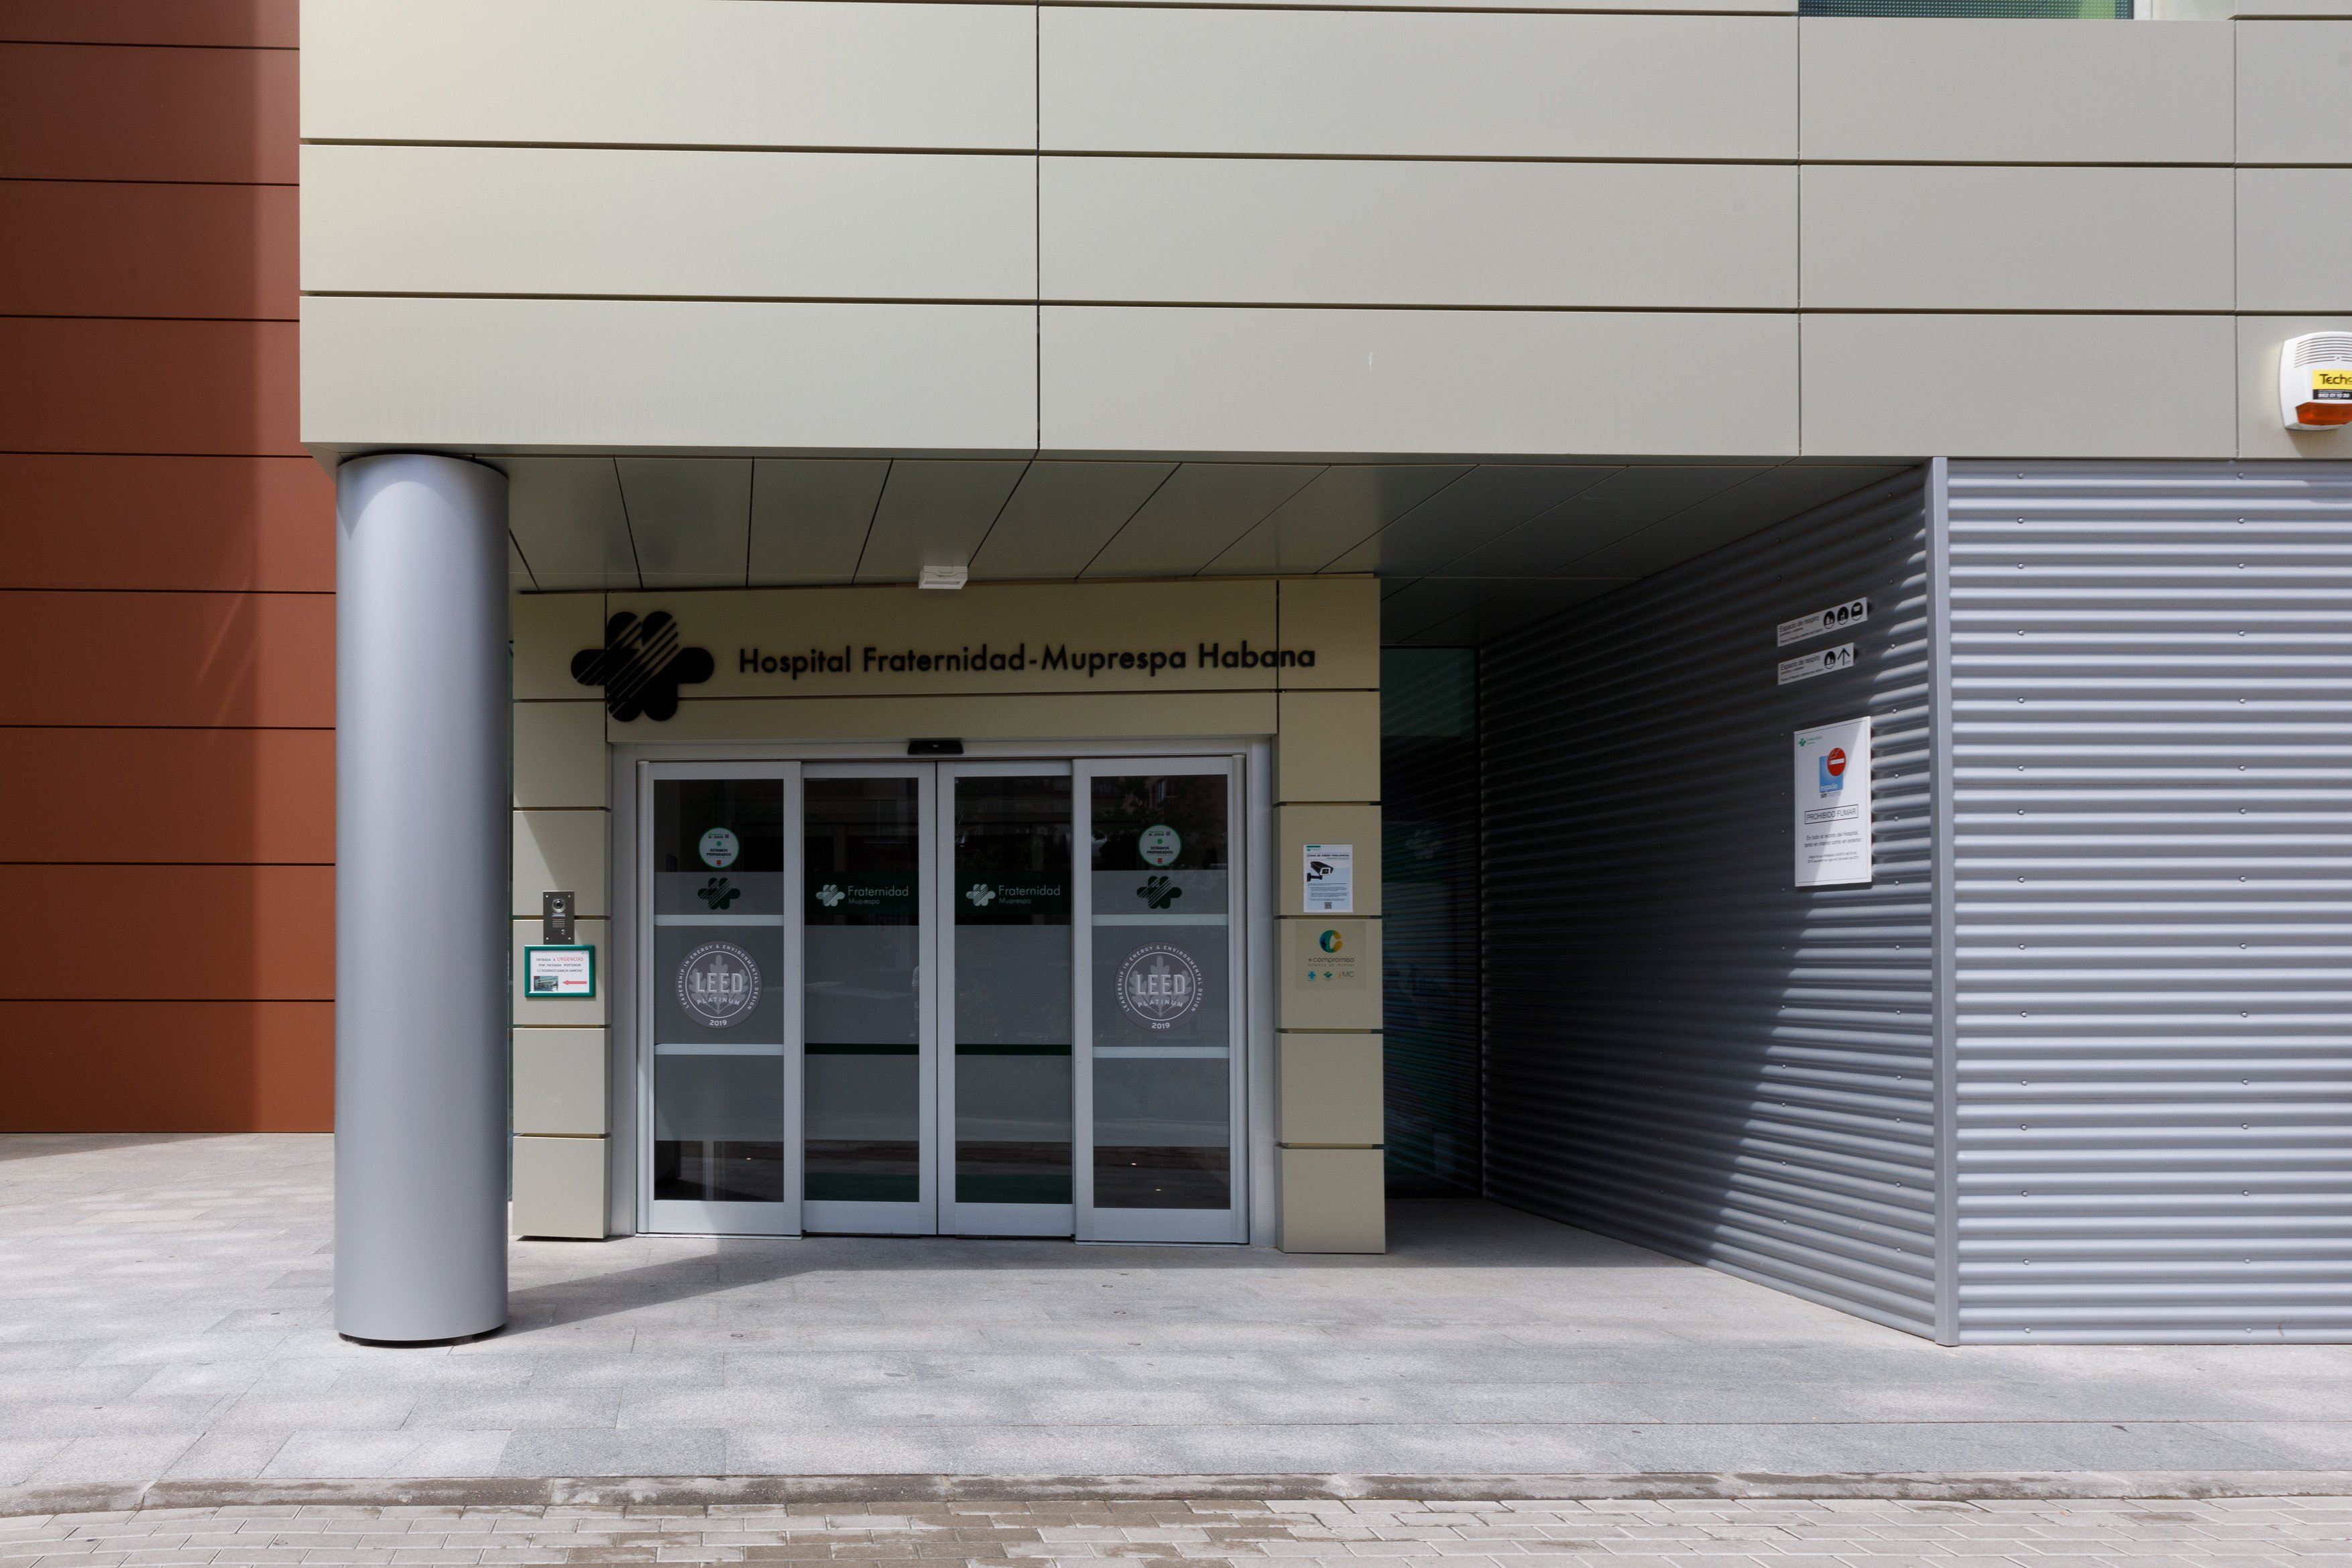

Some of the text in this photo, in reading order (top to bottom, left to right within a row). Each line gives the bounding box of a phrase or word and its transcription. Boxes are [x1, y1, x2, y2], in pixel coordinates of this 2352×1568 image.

[1779, 623, 1797, 632] Espacio
[1804, 615, 1820, 624] respiro
[740, 640, 1315, 680] Hospital Fraternidad-Muprespa Habana
[1780, 661, 1798, 670] Espacio
[1805, 655, 1820, 664] respiro
[1806, 808, 1857, 821] PROHIBIDO FUMAR
[847, 885, 908, 896] Fraternidad
[998, 884, 1061, 896] Fraternidad
[998, 897, 1031, 905] Muprespa
[678, 969, 689, 1009] LEADERSHIP
[690, 945, 713, 959] ENERGY
[722, 945, 759, 983] ENVIRONMENTAL
[747, 987, 759, 1010] DESIGN
[696, 972, 743, 993] LEED
[1117, 971, 1130, 1012] LEADERSHIP
[1129, 945, 1153, 961] ENERGY
[1163, 945, 1203, 985] ENVIRONMENTAL
[1191, 988, 1203, 1012] DESIGN
[1136, 974, 1185, 996] LEED
[697, 997, 741, 1006] PLATINUM
[1137, 999, 1183, 1008] PLATINUM
